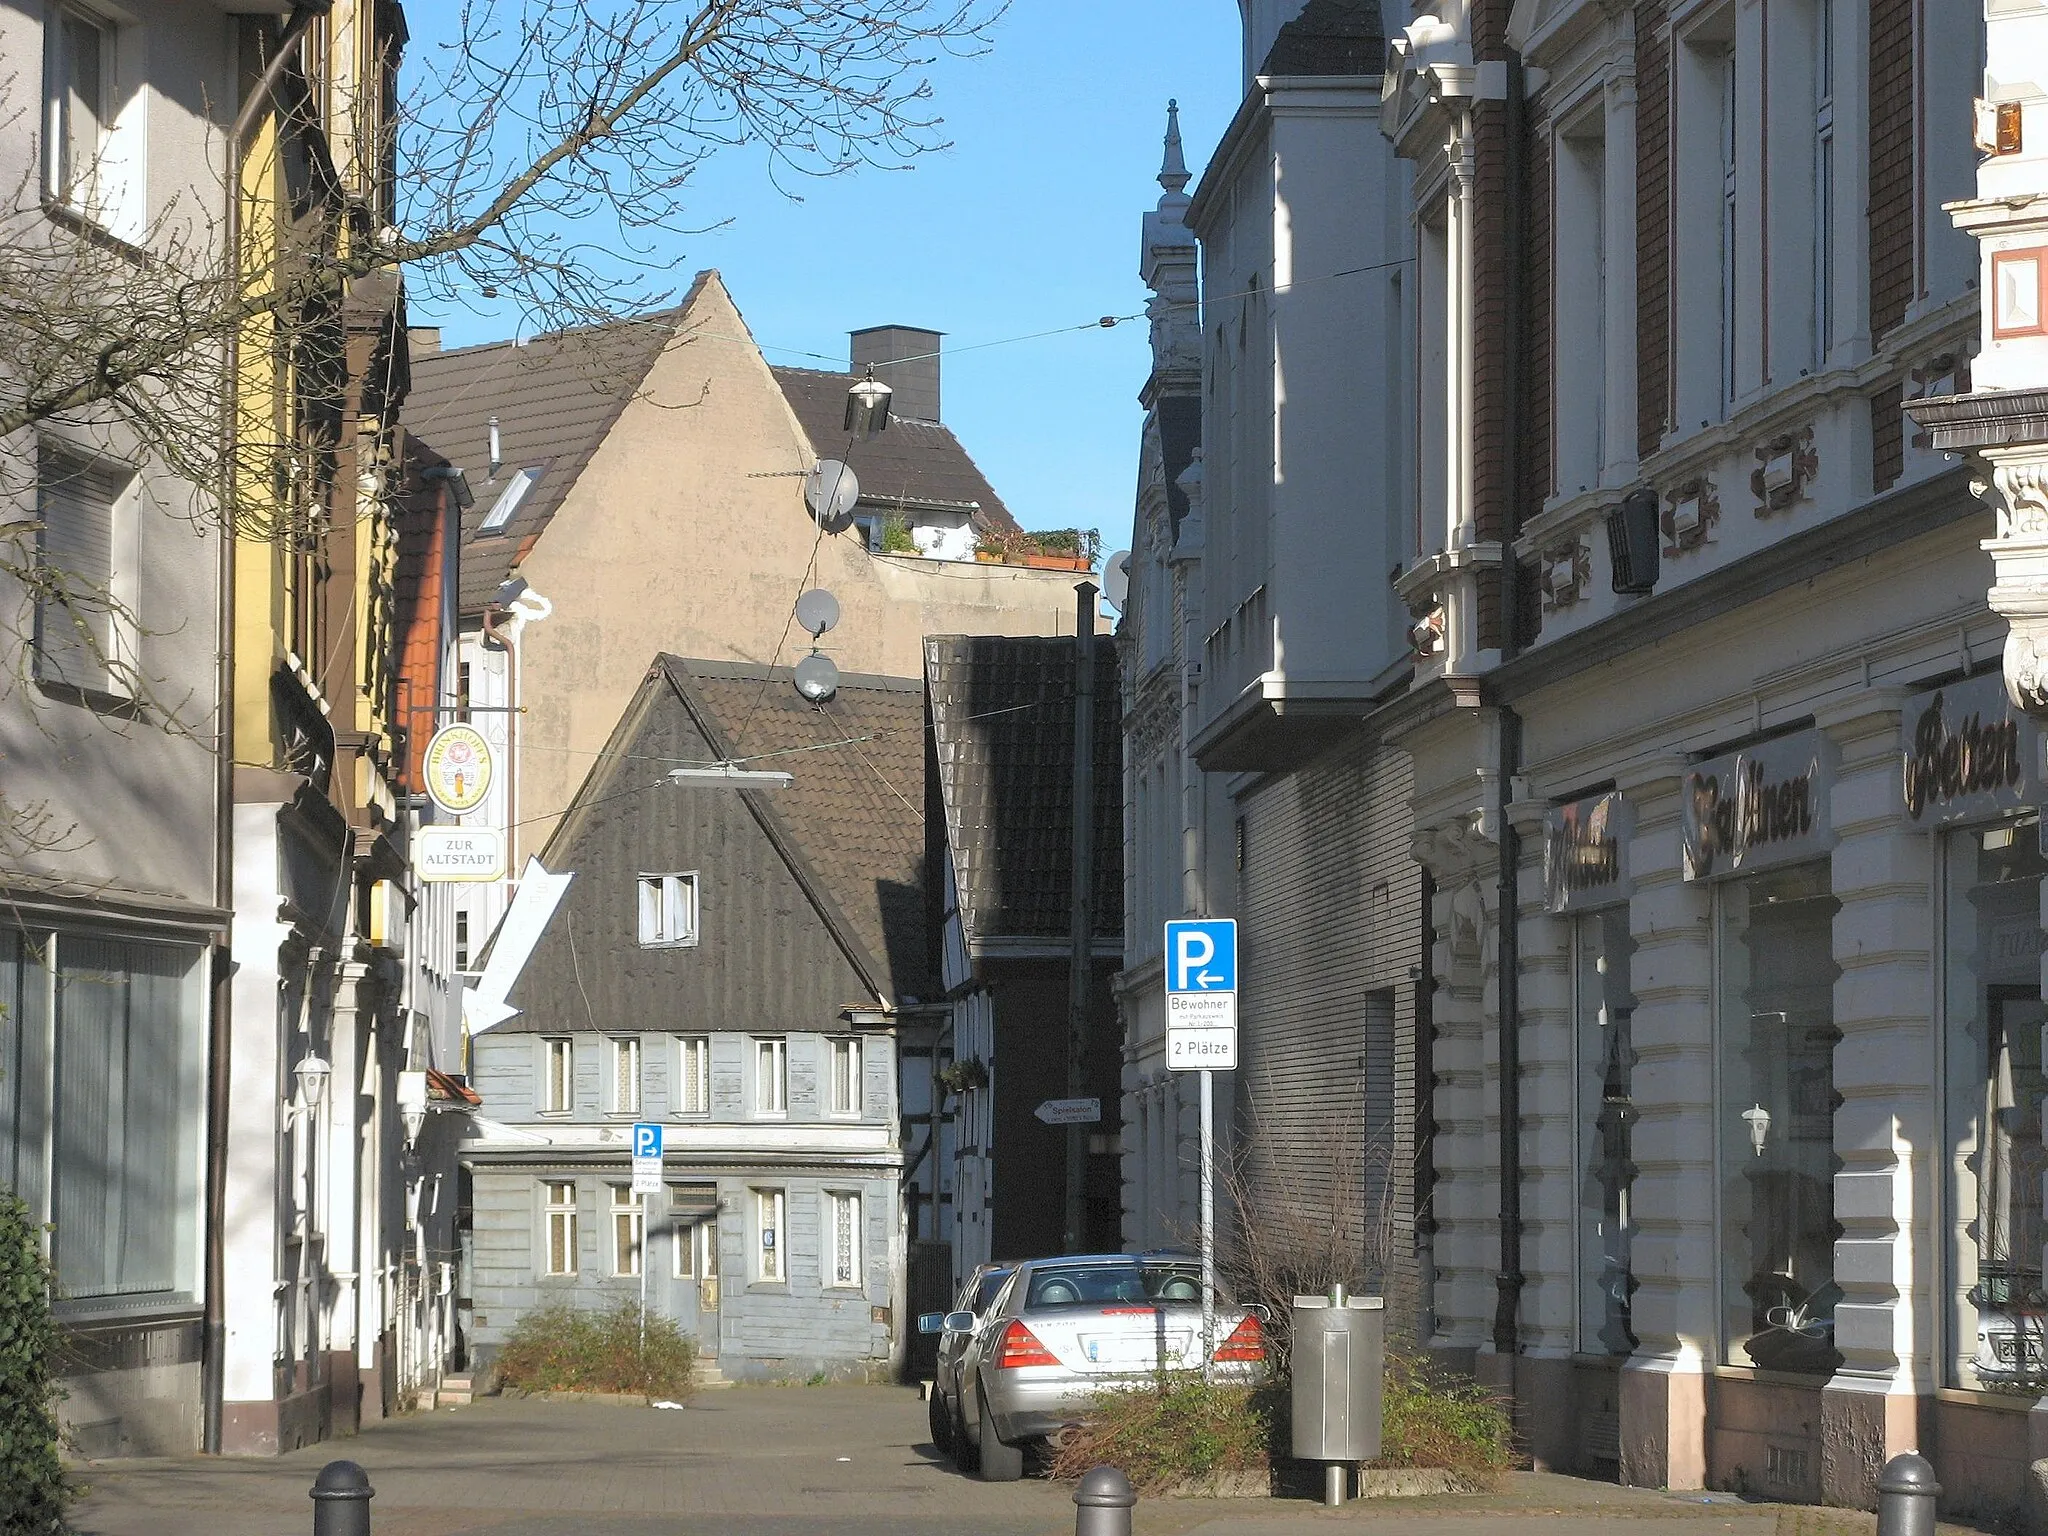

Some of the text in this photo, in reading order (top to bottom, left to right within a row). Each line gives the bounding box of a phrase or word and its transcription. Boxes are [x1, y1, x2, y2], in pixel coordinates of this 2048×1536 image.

[446, 840, 474, 850] ZUR
[426, 854, 495, 865] ALTSTADT
[1177, 931, 1215, 990] P
[1171, 997, 1228, 1010] Bewohner
[1175, 1041, 1228, 1055] 2 Plätze
[637, 1128, 654, 1156] P
